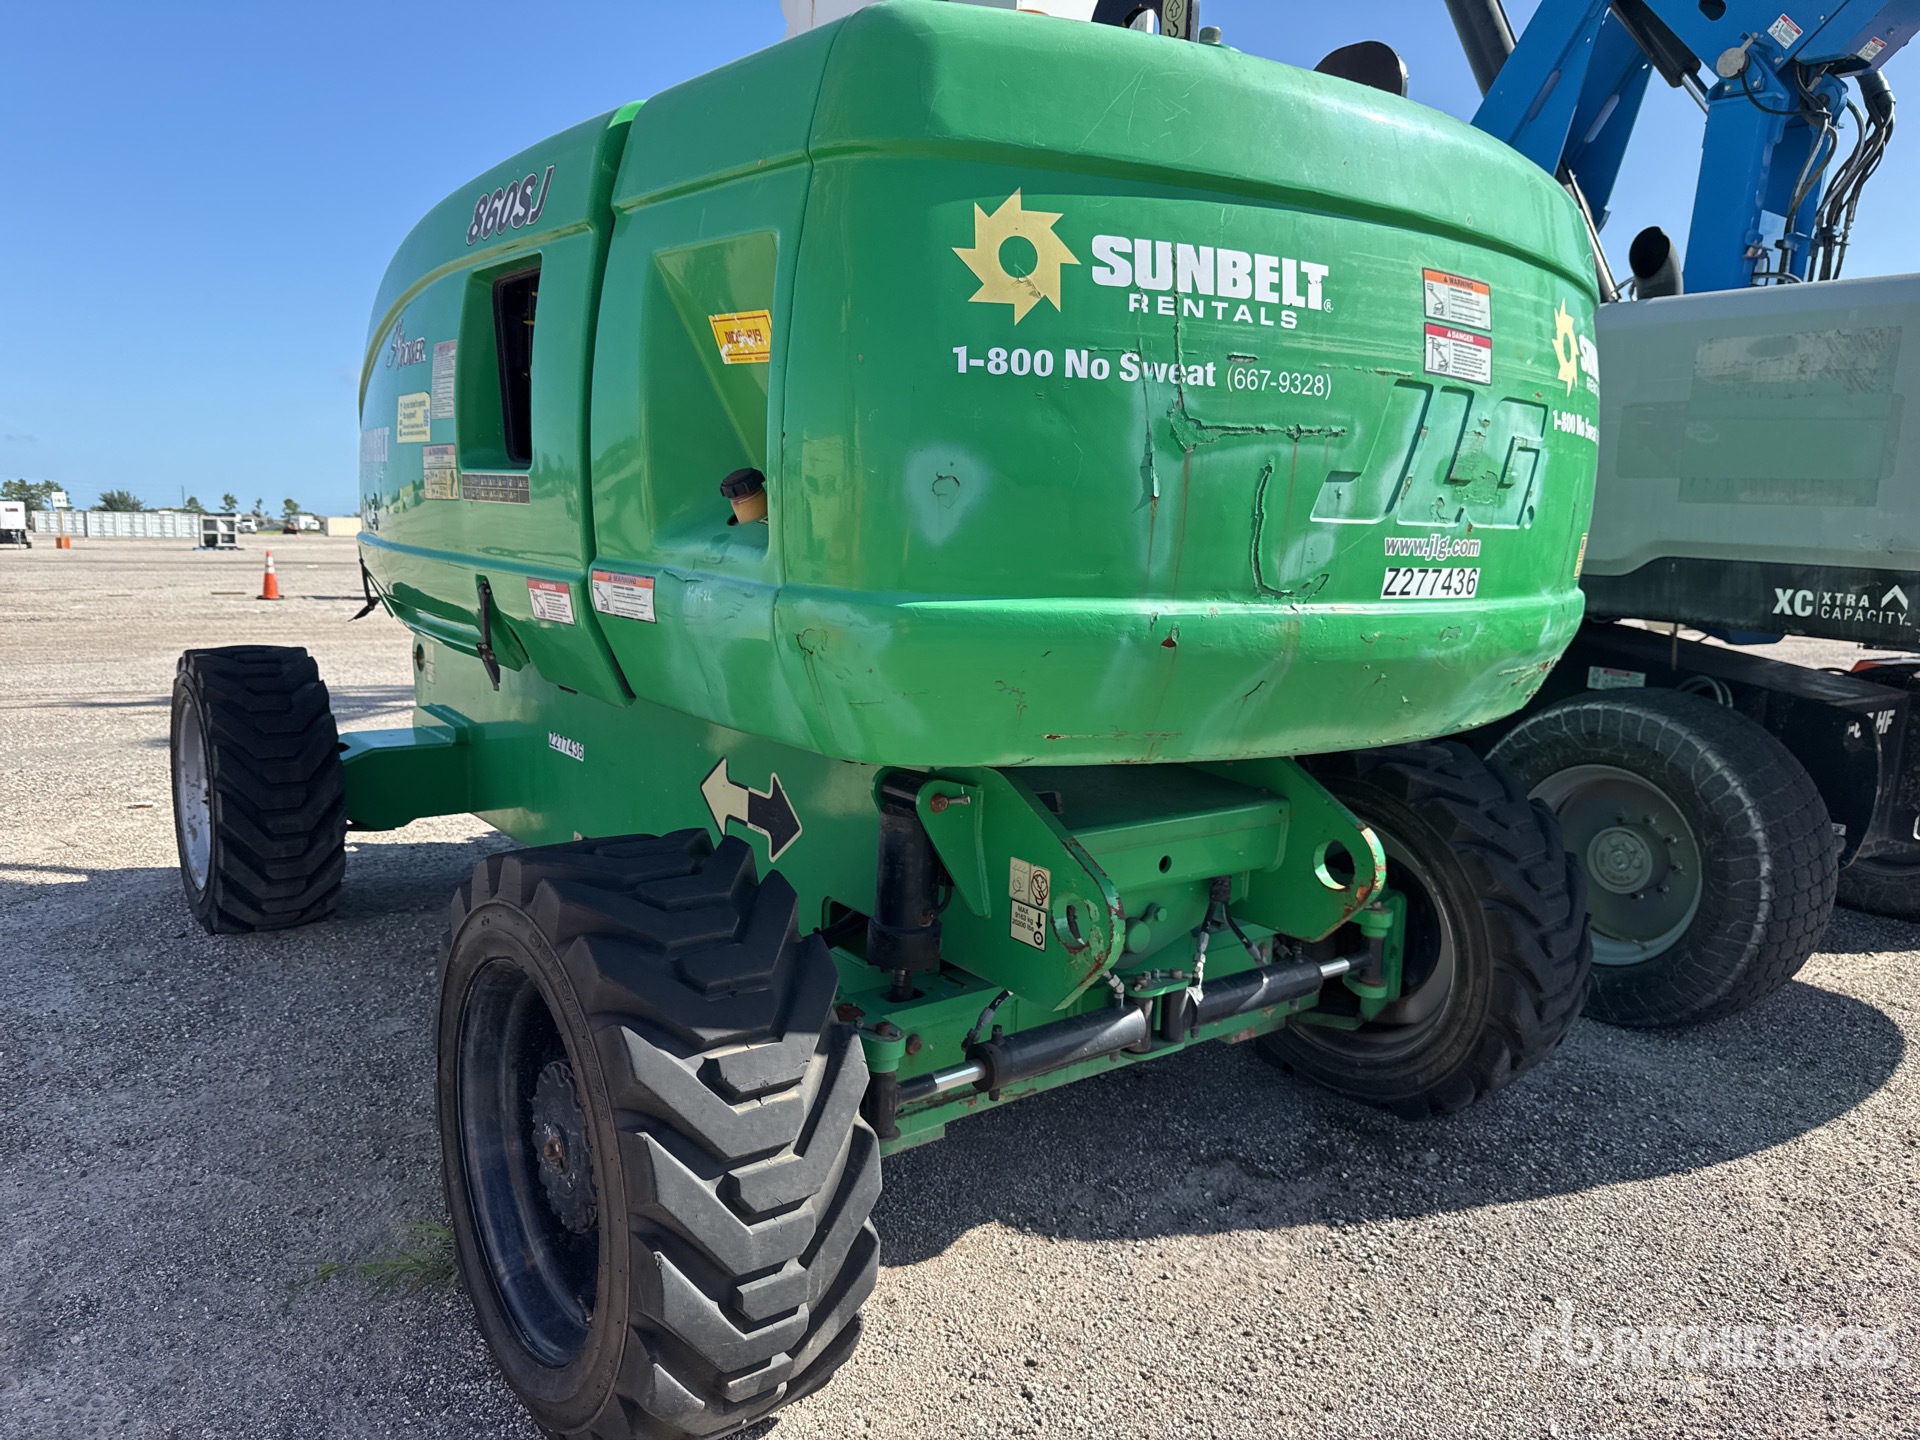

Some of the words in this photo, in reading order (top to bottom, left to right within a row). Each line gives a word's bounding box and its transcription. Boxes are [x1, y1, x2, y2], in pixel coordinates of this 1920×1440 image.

[466, 164, 555, 246] 860SJ
[1091, 234, 1329, 311] SUNBELT
[1128, 293, 1298, 329] RENTALS
[1451, 330, 1474, 343] DANGER
[952, 345, 1054, 378] 1-800
[1064, 349, 1111, 382] No
[1118, 352, 1217, 387] Sweat
[1226, 365, 1333, 400] (667-9328)
[1384, 533, 1481, 561] www.jlg.com
[1383, 567, 1478, 596] Z277436
[1772, 587, 1814, 617] XC
[1821, 591, 1870, 608] XTRA
[1820, 605, 1907, 626] CAPACITY
[550, 731, 584, 760] Z277436
[1017, 905, 1029, 915] MAX
